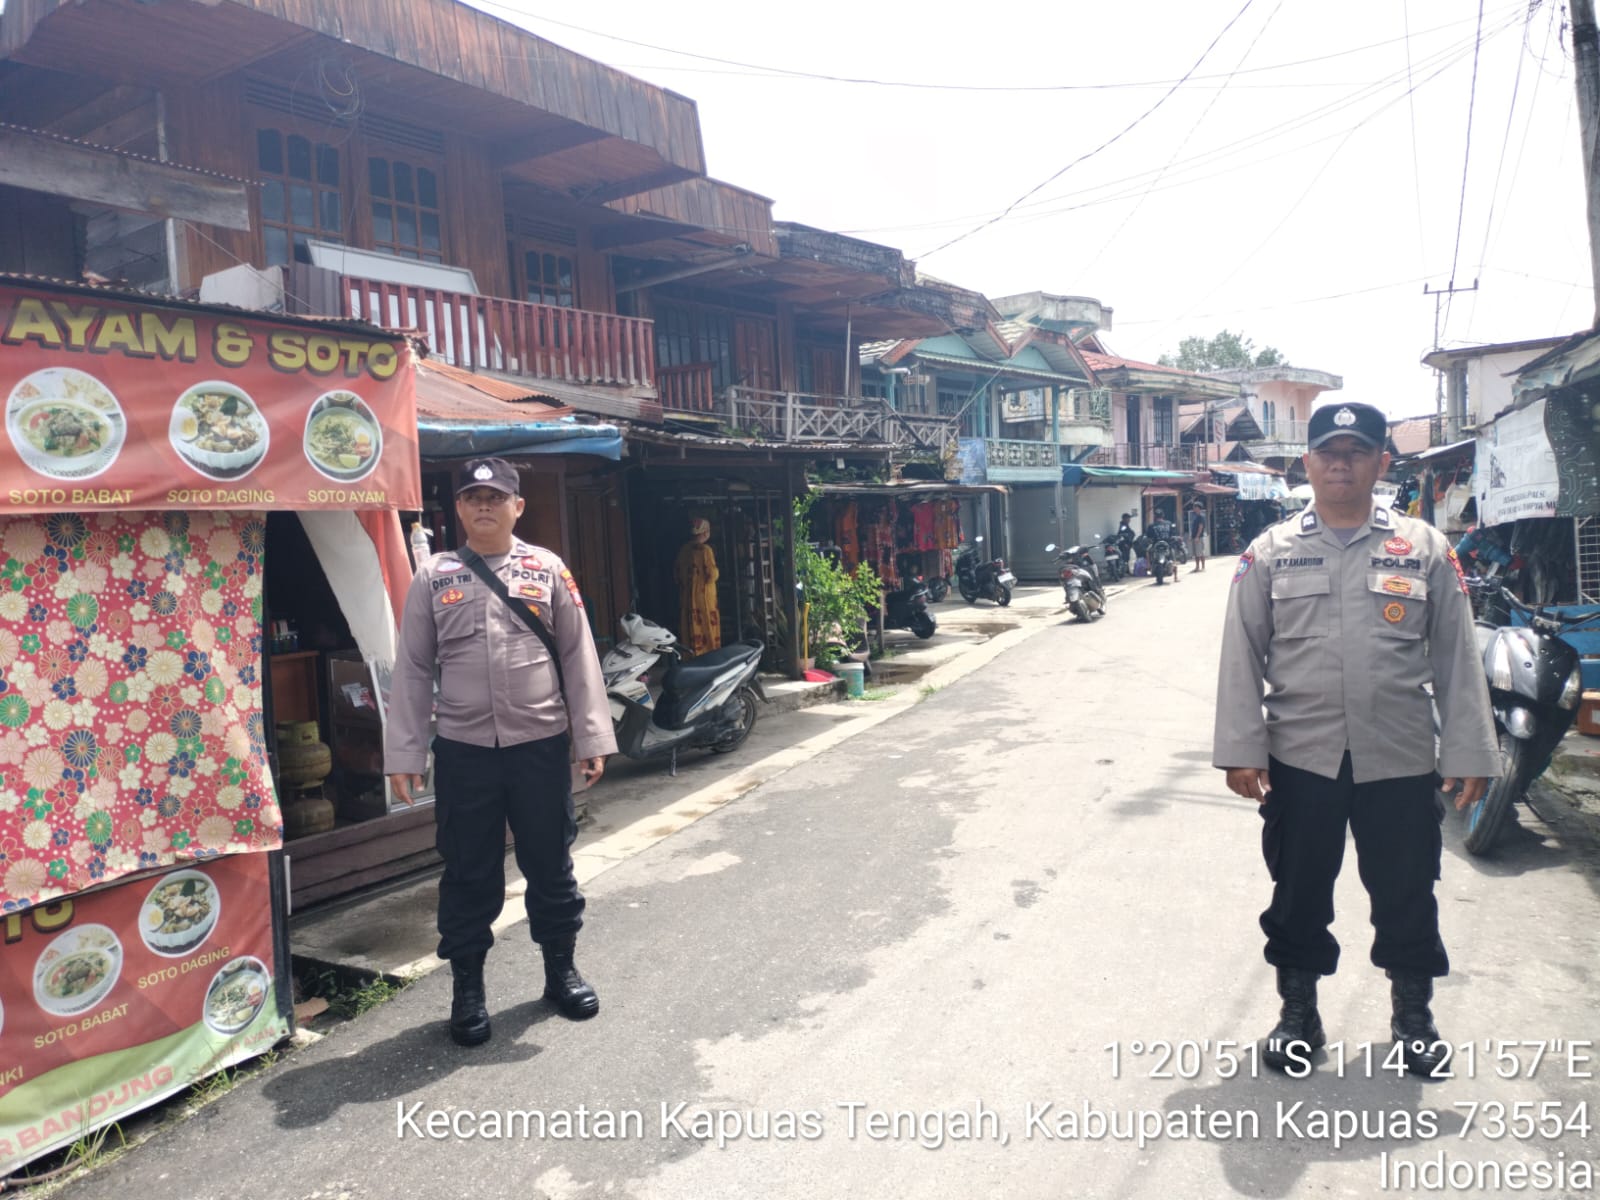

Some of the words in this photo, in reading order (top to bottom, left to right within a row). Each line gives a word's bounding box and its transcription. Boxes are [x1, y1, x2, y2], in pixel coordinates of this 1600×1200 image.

[5, 299, 197, 361] AYAM
[212, 322, 254, 368] &
[267, 331, 399, 380] SOTO
[9, 489, 66, 505] SOTO
[71, 489, 134, 504] BABAT
[167, 489, 212, 503] SOTO
[216, 489, 275, 503] DAGING
[307, 490, 347, 503] SOTO
[349, 490, 385, 503] AYAM
[1370, 556, 1421, 570] POLRI
[432, 576, 454, 590] DEDI
[511, 569, 549, 585] POLRI
[137, 966, 178, 990] SOTO
[179, 945, 231, 975] DAGING
[33, 1023, 78, 1050] SOTO
[81, 1003, 129, 1031] BABAT
[16, 1065, 174, 1149] BANDUNG
